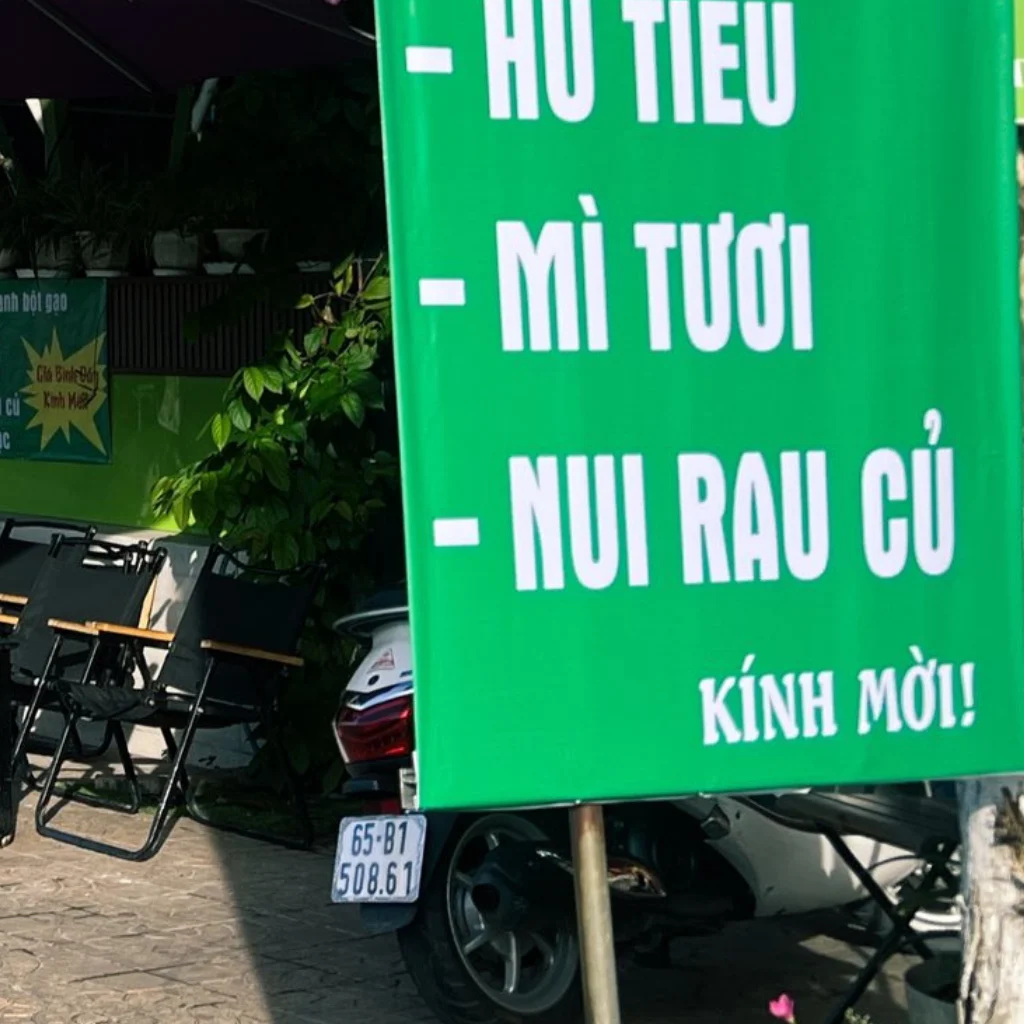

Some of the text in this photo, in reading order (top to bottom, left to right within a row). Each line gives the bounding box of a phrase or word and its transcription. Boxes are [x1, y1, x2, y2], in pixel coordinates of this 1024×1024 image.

[495, 194, 609, 352] MÌ
[633, 212, 813, 352] TƯƠI
[508, 454, 650, 591] NUI
[678, 450, 830, 585] RAU
[861, 408, 956, 578] CỦ
[699, 645, 976, 746] KÍNH MỜI!
[336, 860, 413, 896] 508.61
[351, 821, 408, 856] 65-B1
